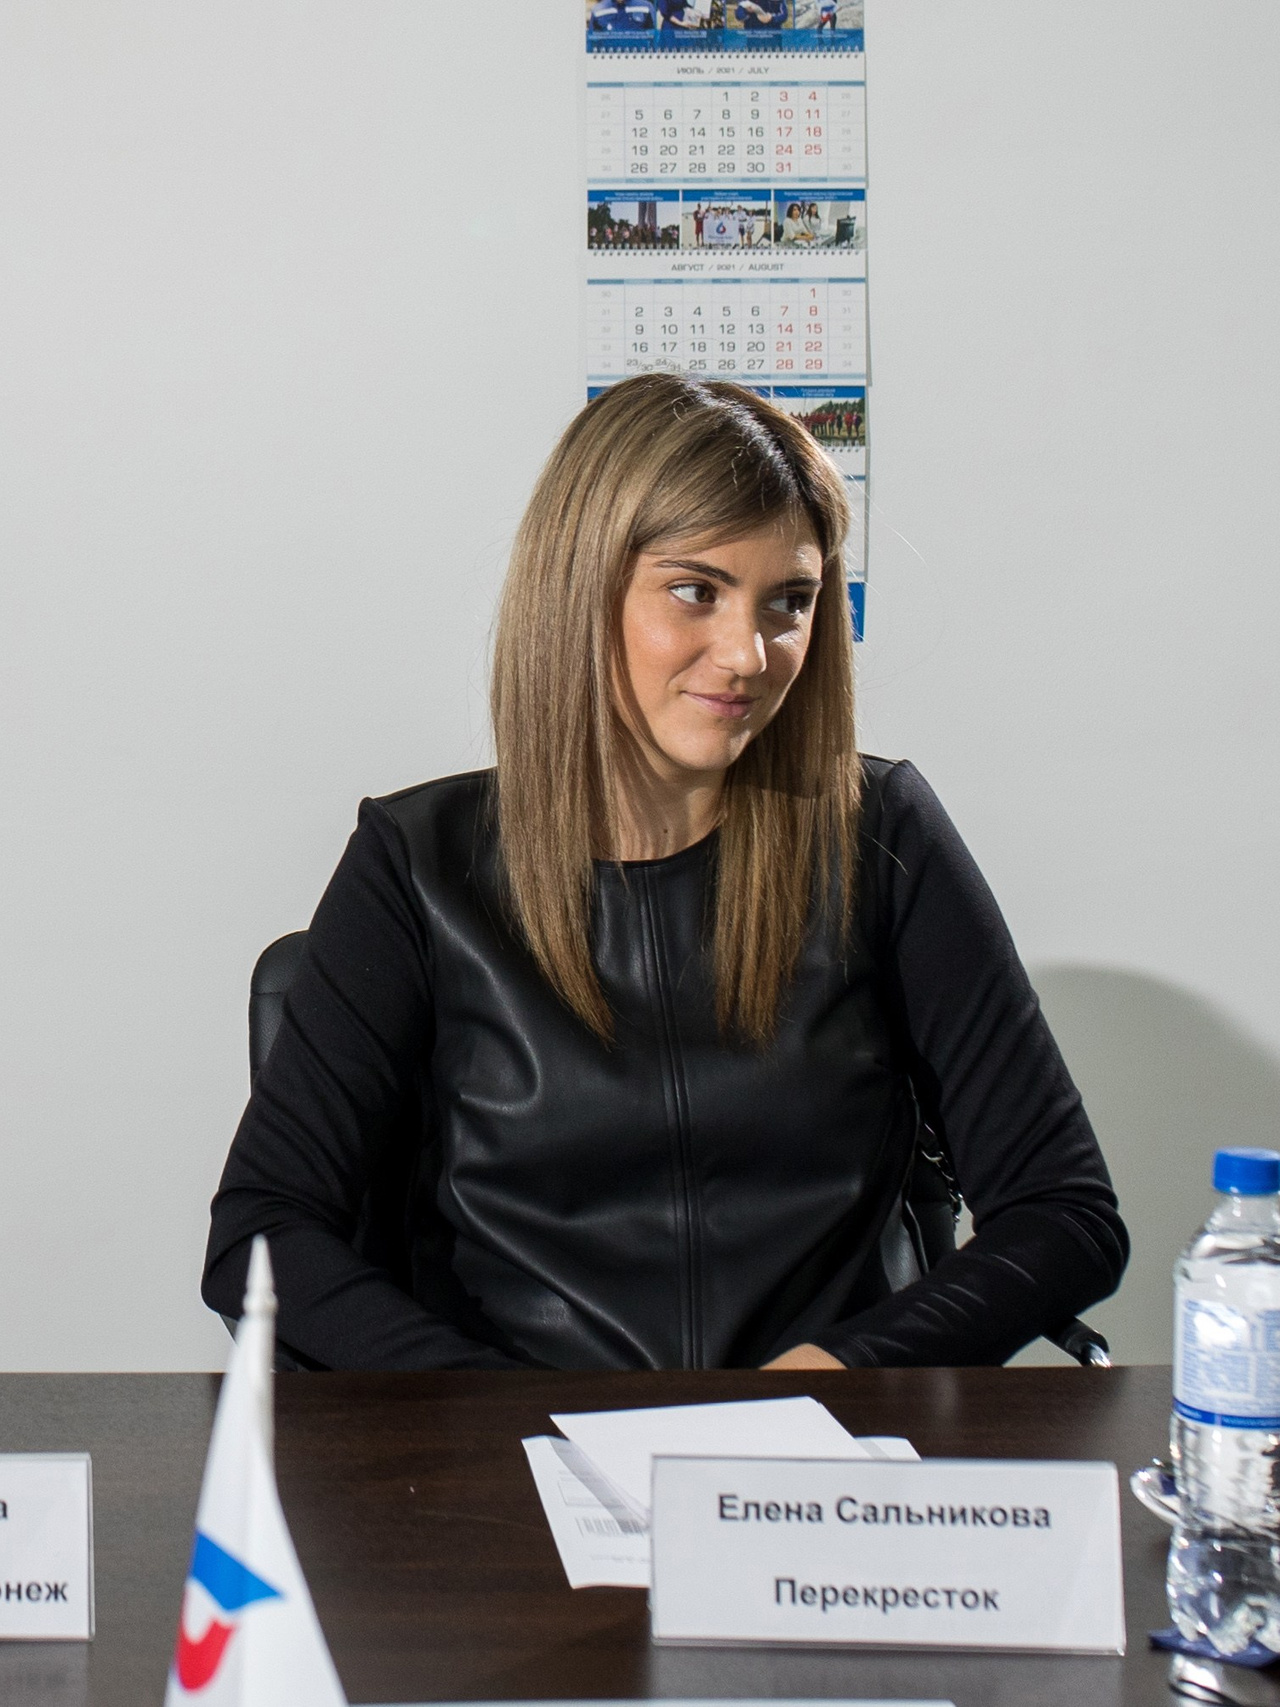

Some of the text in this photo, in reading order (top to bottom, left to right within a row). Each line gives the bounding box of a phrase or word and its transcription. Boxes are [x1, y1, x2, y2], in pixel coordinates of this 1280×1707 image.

[676, 66, 705, 75] ИЮЛЬ
[747, 66, 770, 75] JULY
[723, 91, 729, 102] 1
[750, 90, 760, 102] 2
[779, 90, 789, 102] 3
[808, 90, 817, 102] 4
[634, 109, 644, 121] 5
[663, 109, 673, 121] 6
[693, 108, 702, 120] 7
[721, 108, 731, 120] 8
[750, 108, 760, 120] 9
[776, 108, 794, 120] 10
[805, 108, 820, 119] 11
[632, 127, 649, 138] 12
[661, 127, 678, 138] 13
[689, 126, 706, 137] 14
[719, 126, 736, 138] 15
[748, 126, 765, 138] 16
[776, 126, 793, 137] 17
[805, 126, 822, 138] 18
[632, 144, 649, 156] 19
[659, 144, 679, 156] 20
[688, 144, 705, 156] 21
[717, 144, 736, 156] 22
[746, 144, 765, 156] 23
[775, 144, 793, 155] 24
[804, 143, 823, 156] 25
[630, 162, 649, 174] 26
[659, 162, 678, 174] 27
[688, 162, 707, 174] 28
[717, 162, 736, 174] 29
[746, 161, 766, 174] 30
[775, 161, 792, 173] 31
[671, 263, 705, 272] АВГУСТ
[716, 263, 736, 271] 2021
[748, 262, 785, 272] AUGUST
[809, 287, 816, 299] 1
[634, 306, 644, 318] 2
[664, 305, 673, 318] 3
[692, 306, 702, 317] 4
[722, 305, 732, 317] 5
[751, 305, 760, 317] 6
[780, 305, 789, 317] 7
[809, 305, 818, 317] 8
[634, 324, 645, 336] 9
[660, 323, 679, 335] 10
[689, 323, 705, 335] 11
[719, 323, 736, 335] 12
[748, 323, 765, 335] 13
[777, 323, 794, 334] 14
[806, 323, 823, 335] 15
[631, 341, 649, 354] 16
[660, 341, 678, 353] 17
[690, 341, 707, 353] 18
[719, 341, 736, 353] 19
[746, 341, 766, 353] 20
[775, 340, 792, 353] 21
[804, 340, 823, 352] 22
[688, 358, 707, 371] 25
[717, 359, 737, 371] 26
[746, 358, 765, 370] 27
[775, 358, 794, 370] 28
[804, 358, 823, 370] 29
[718, 1494, 1051, 1528] Елена Сальникова
[774, 1577, 999, 1614] Перекресток
